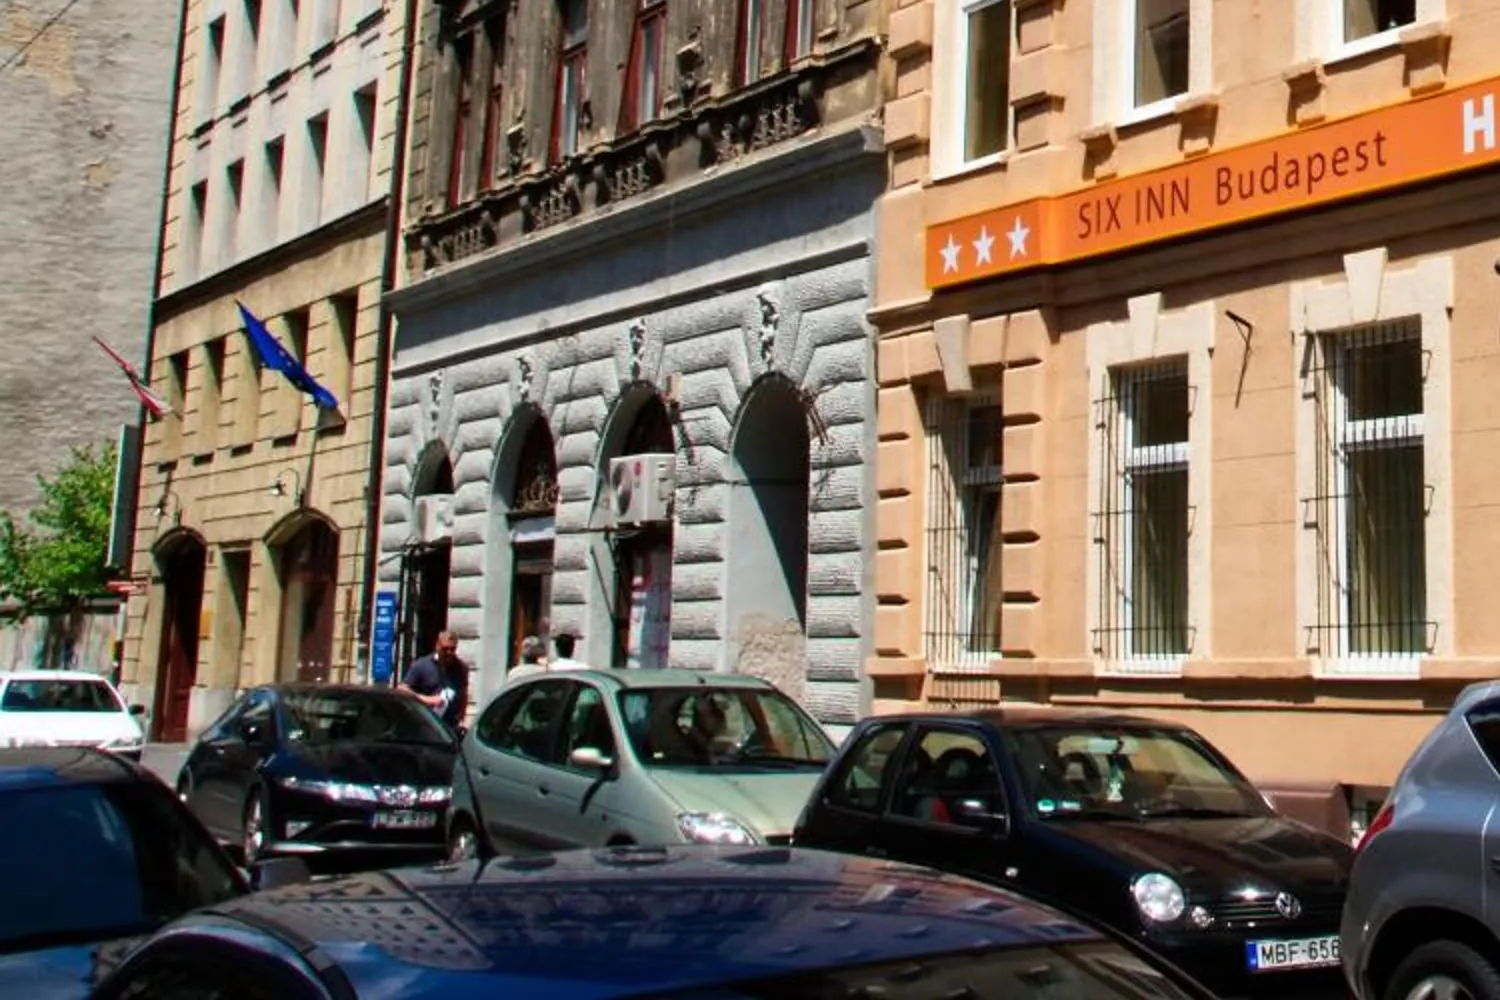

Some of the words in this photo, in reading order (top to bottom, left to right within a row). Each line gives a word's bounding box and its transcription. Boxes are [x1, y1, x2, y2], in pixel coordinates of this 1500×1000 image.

[1077, 193, 1122, 240] SIX
[1135, 176, 1190, 226] INN
[1215, 129, 1388, 207] Budapest
